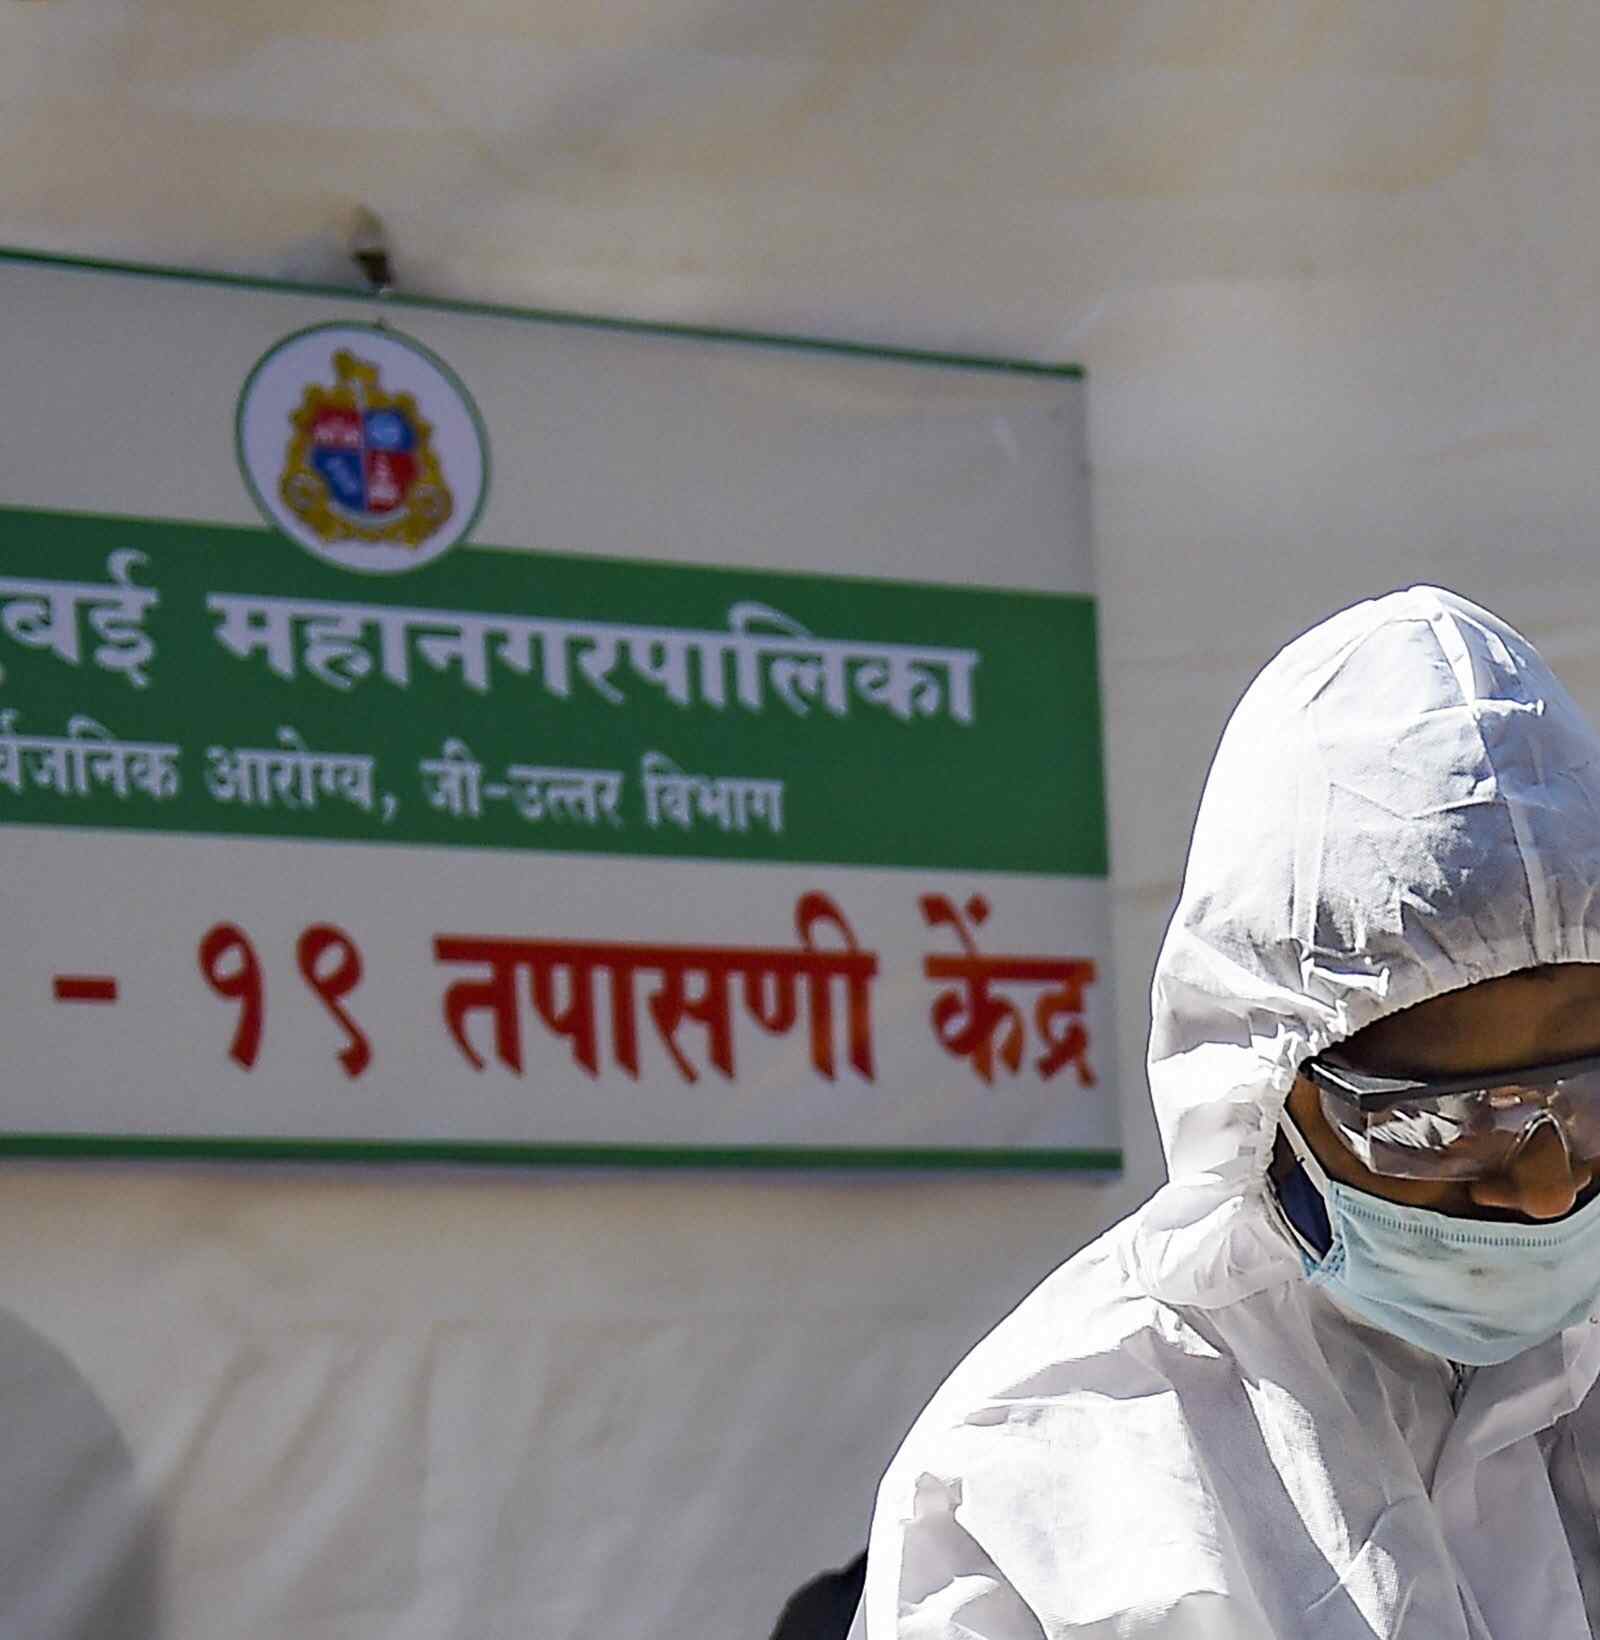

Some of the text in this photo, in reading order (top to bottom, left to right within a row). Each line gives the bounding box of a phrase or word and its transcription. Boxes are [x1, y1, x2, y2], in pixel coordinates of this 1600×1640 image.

[0, 550, 981, 725] बई महानगरपालिका
[0, 711, 180, 799] र्वजनिक
[207, 726, 396, 820] आरोग्य,
[641, 751, 784, 832] विभाग
[198, 922, 371, 1078] १९
[433, 891, 878, 1082] तपासणी
[919, 893, 1097, 1086] केंद्र
